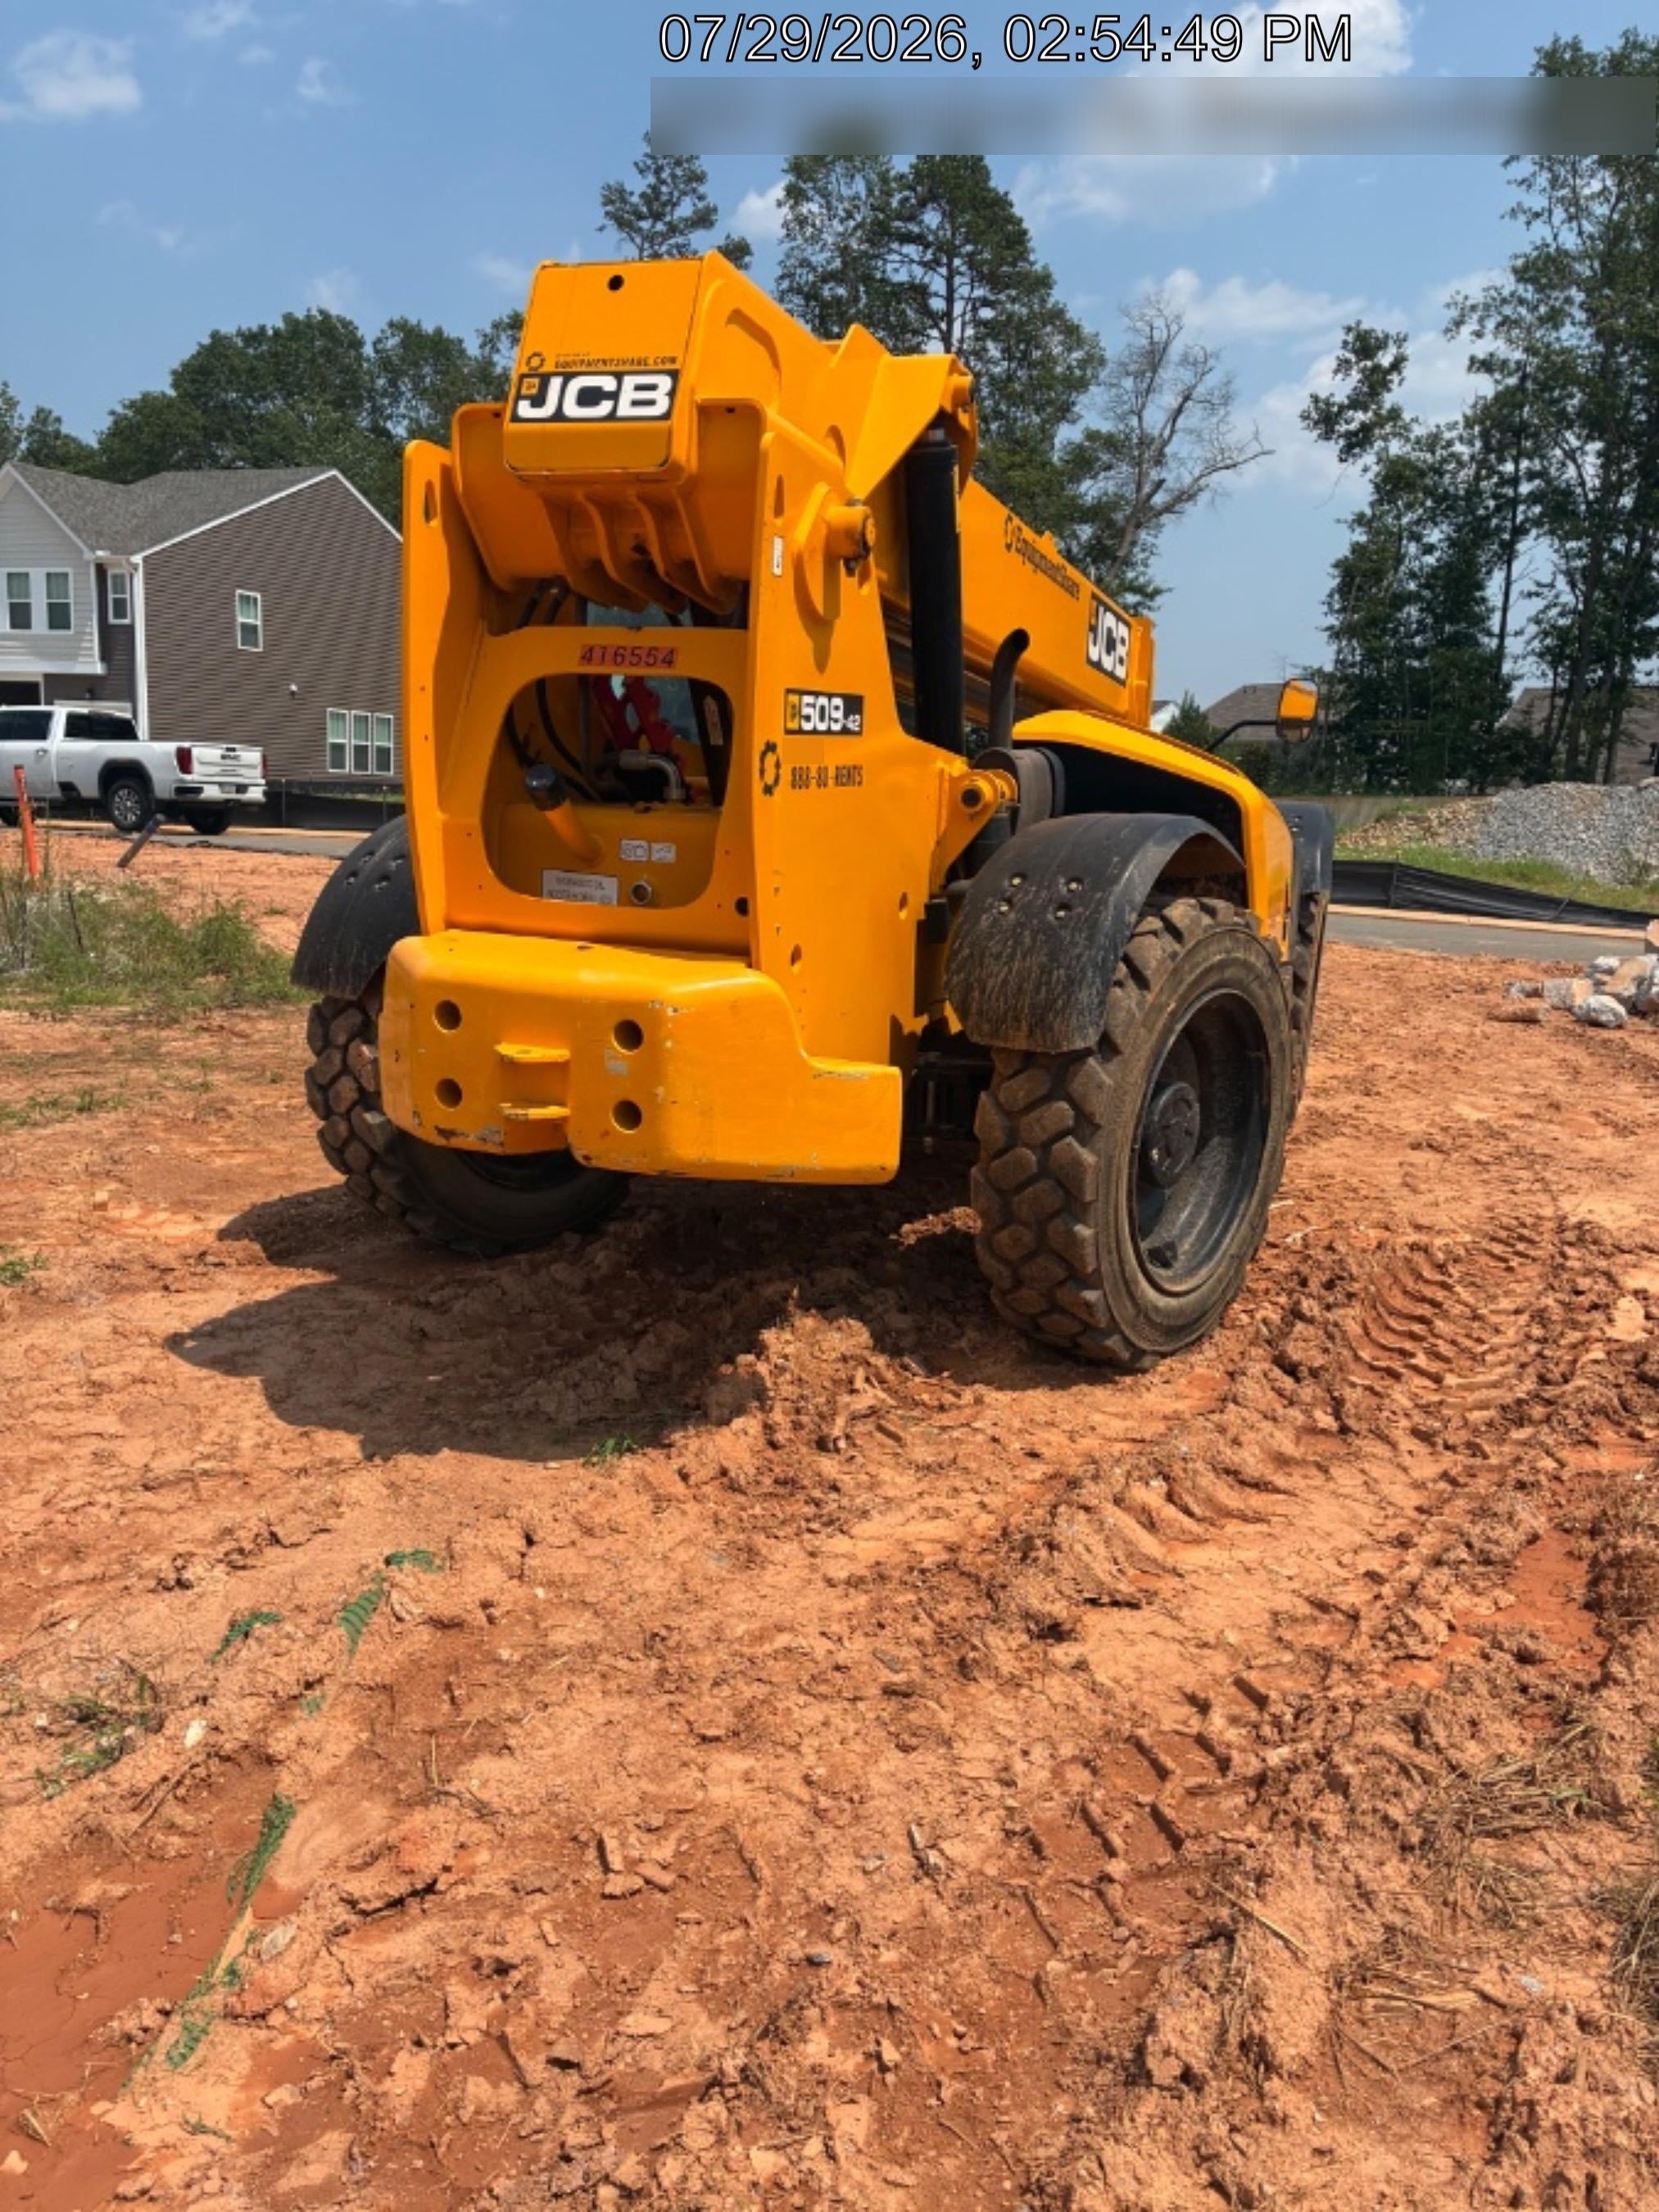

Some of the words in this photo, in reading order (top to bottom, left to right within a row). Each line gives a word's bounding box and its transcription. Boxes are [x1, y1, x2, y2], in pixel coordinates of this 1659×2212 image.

[516, 374, 674, 419] JCB
[580, 645, 675, 668] 416554
[1087, 604, 1130, 681] JCB
